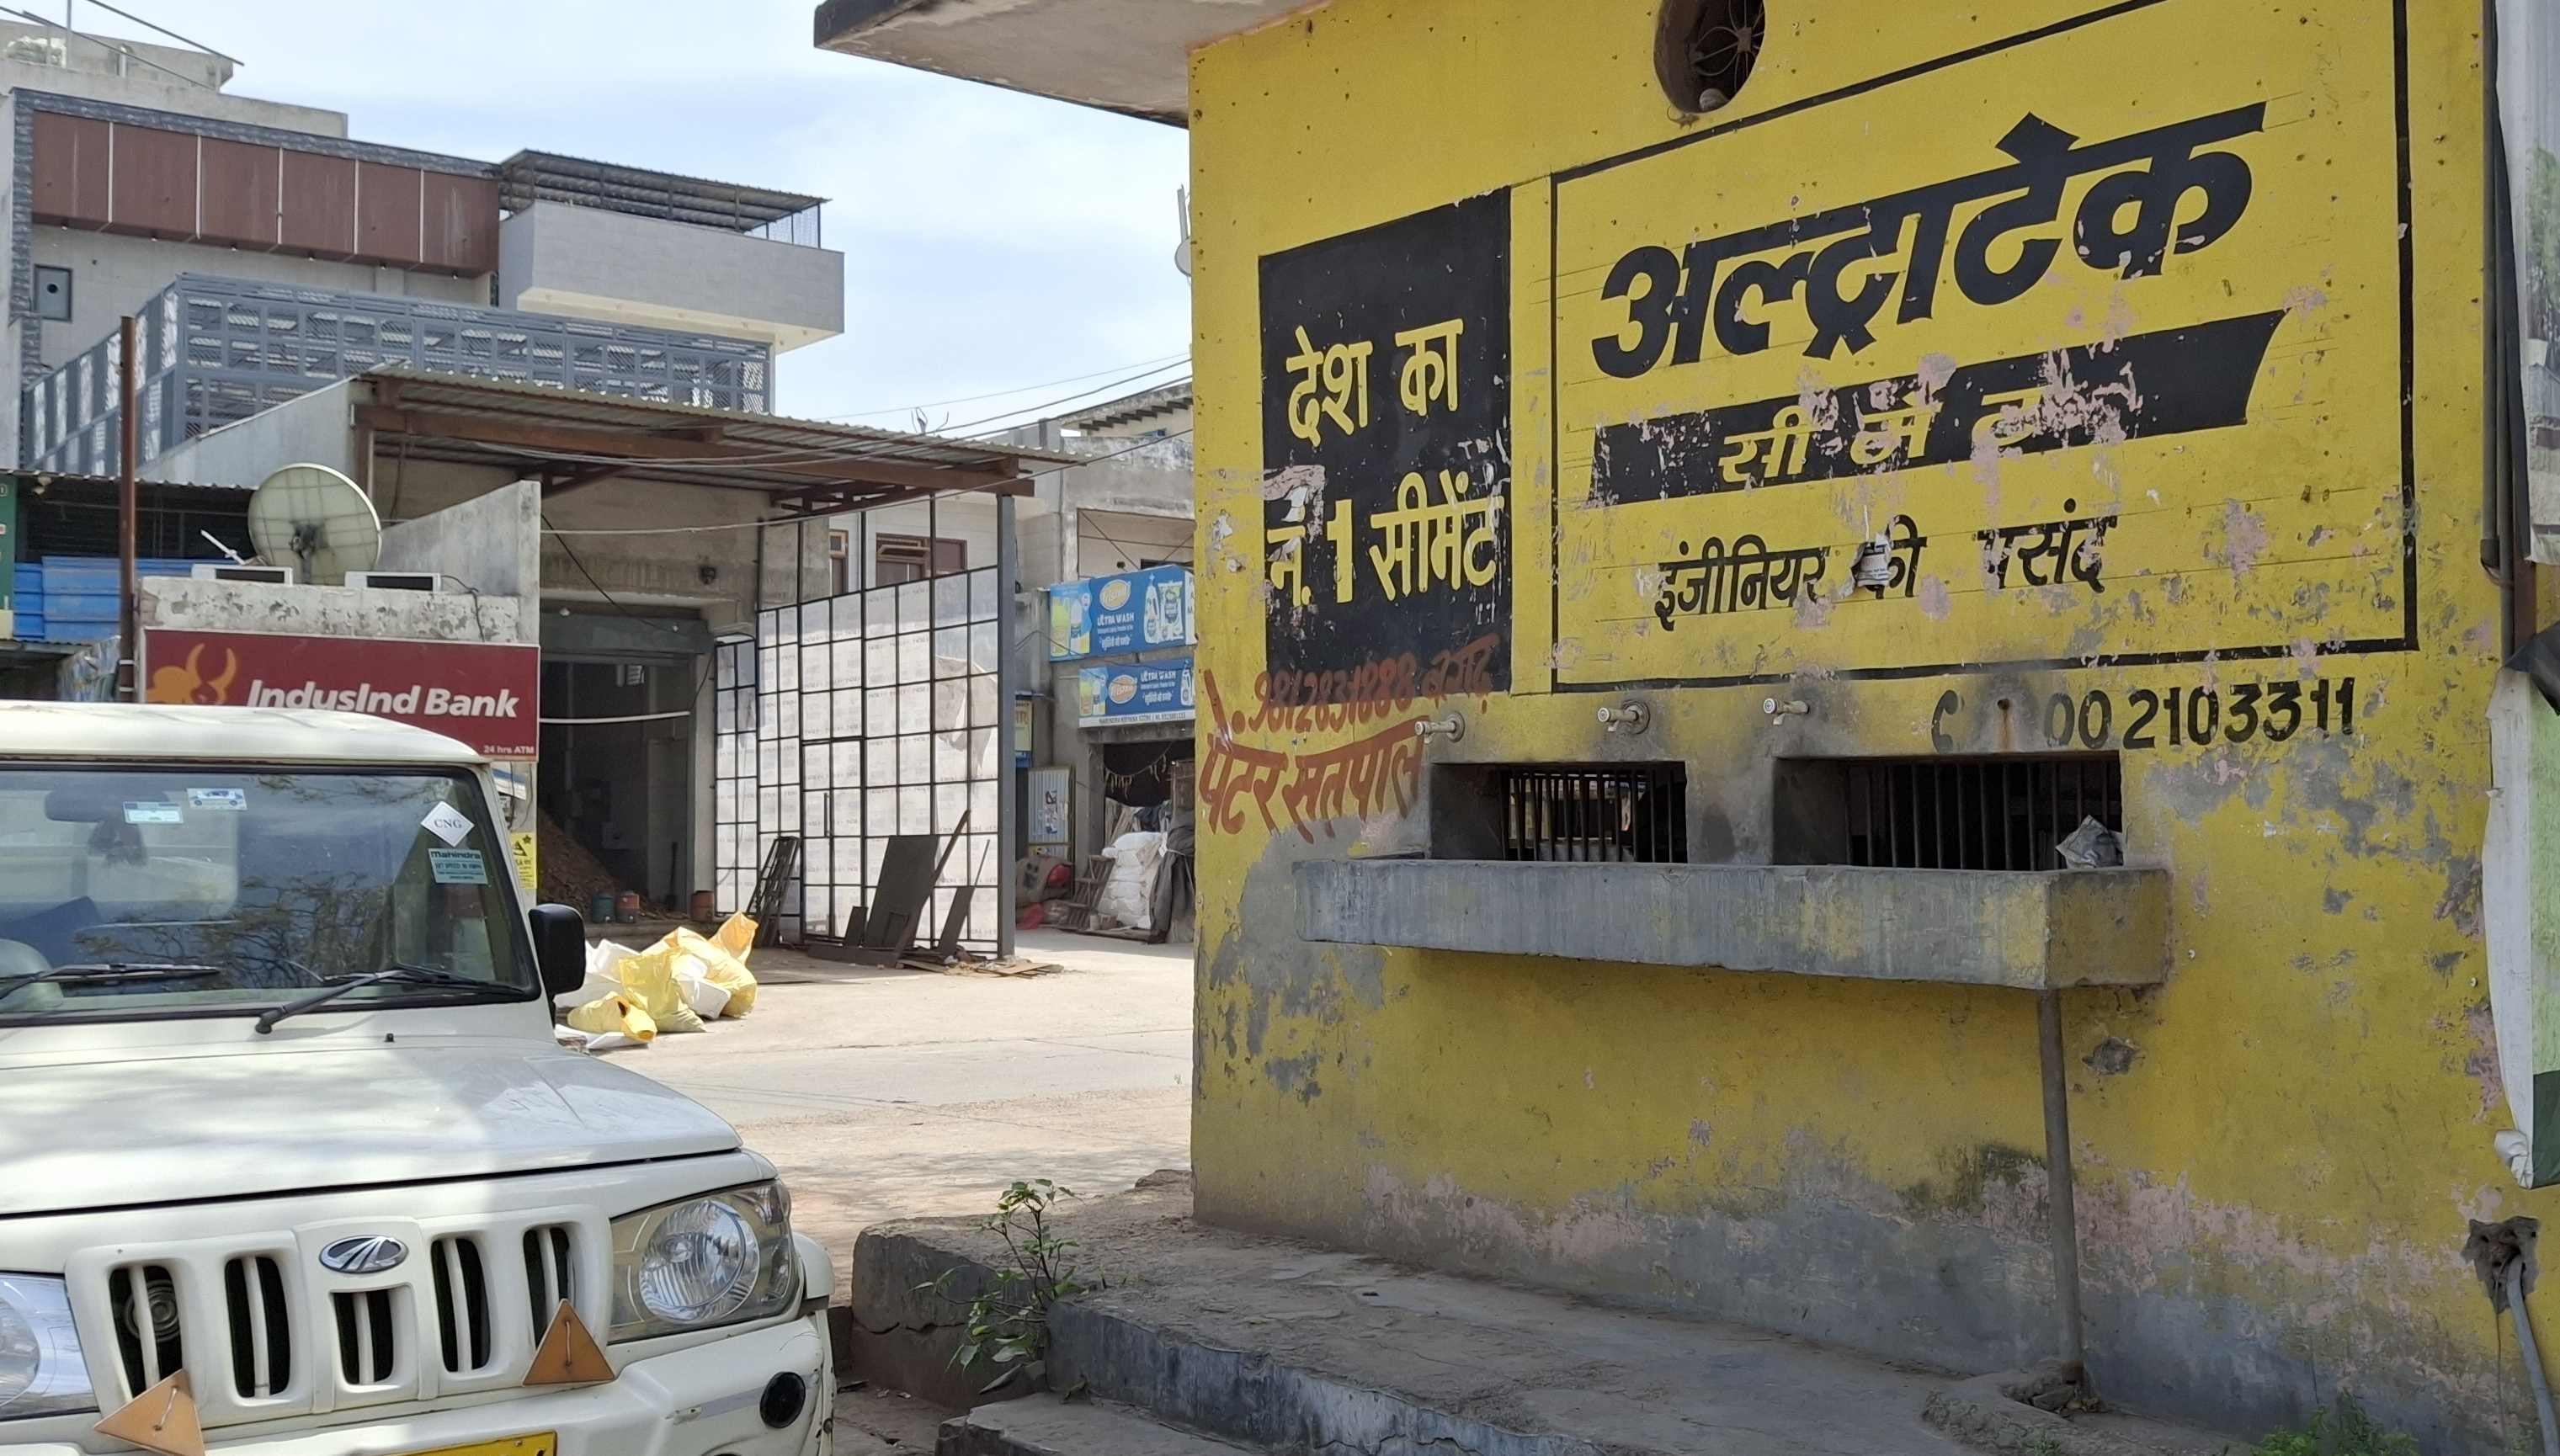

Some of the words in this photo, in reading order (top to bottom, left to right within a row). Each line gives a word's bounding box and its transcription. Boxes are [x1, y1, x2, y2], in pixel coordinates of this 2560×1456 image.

[1591, 102, 2266, 378] अल्ट्राटेक
[1286, 325, 1373, 447] देश
[1395, 318, 1463, 416] का
[1327, 499, 1353, 603] 1
[1369, 469, 1505, 601] सीमेंट
[1655, 534, 1830, 631] इंजीनियर
[247, 679, 421, 715] IndusInd
[424, 688, 520, 718] Bank
[483, 745, 495, 754] 24
[497, 745, 512, 754] hrs
[514, 746, 535, 754] ATM
[434, 818, 463, 829] CNG
[1282, 715, 1430, 843] सतपाल
